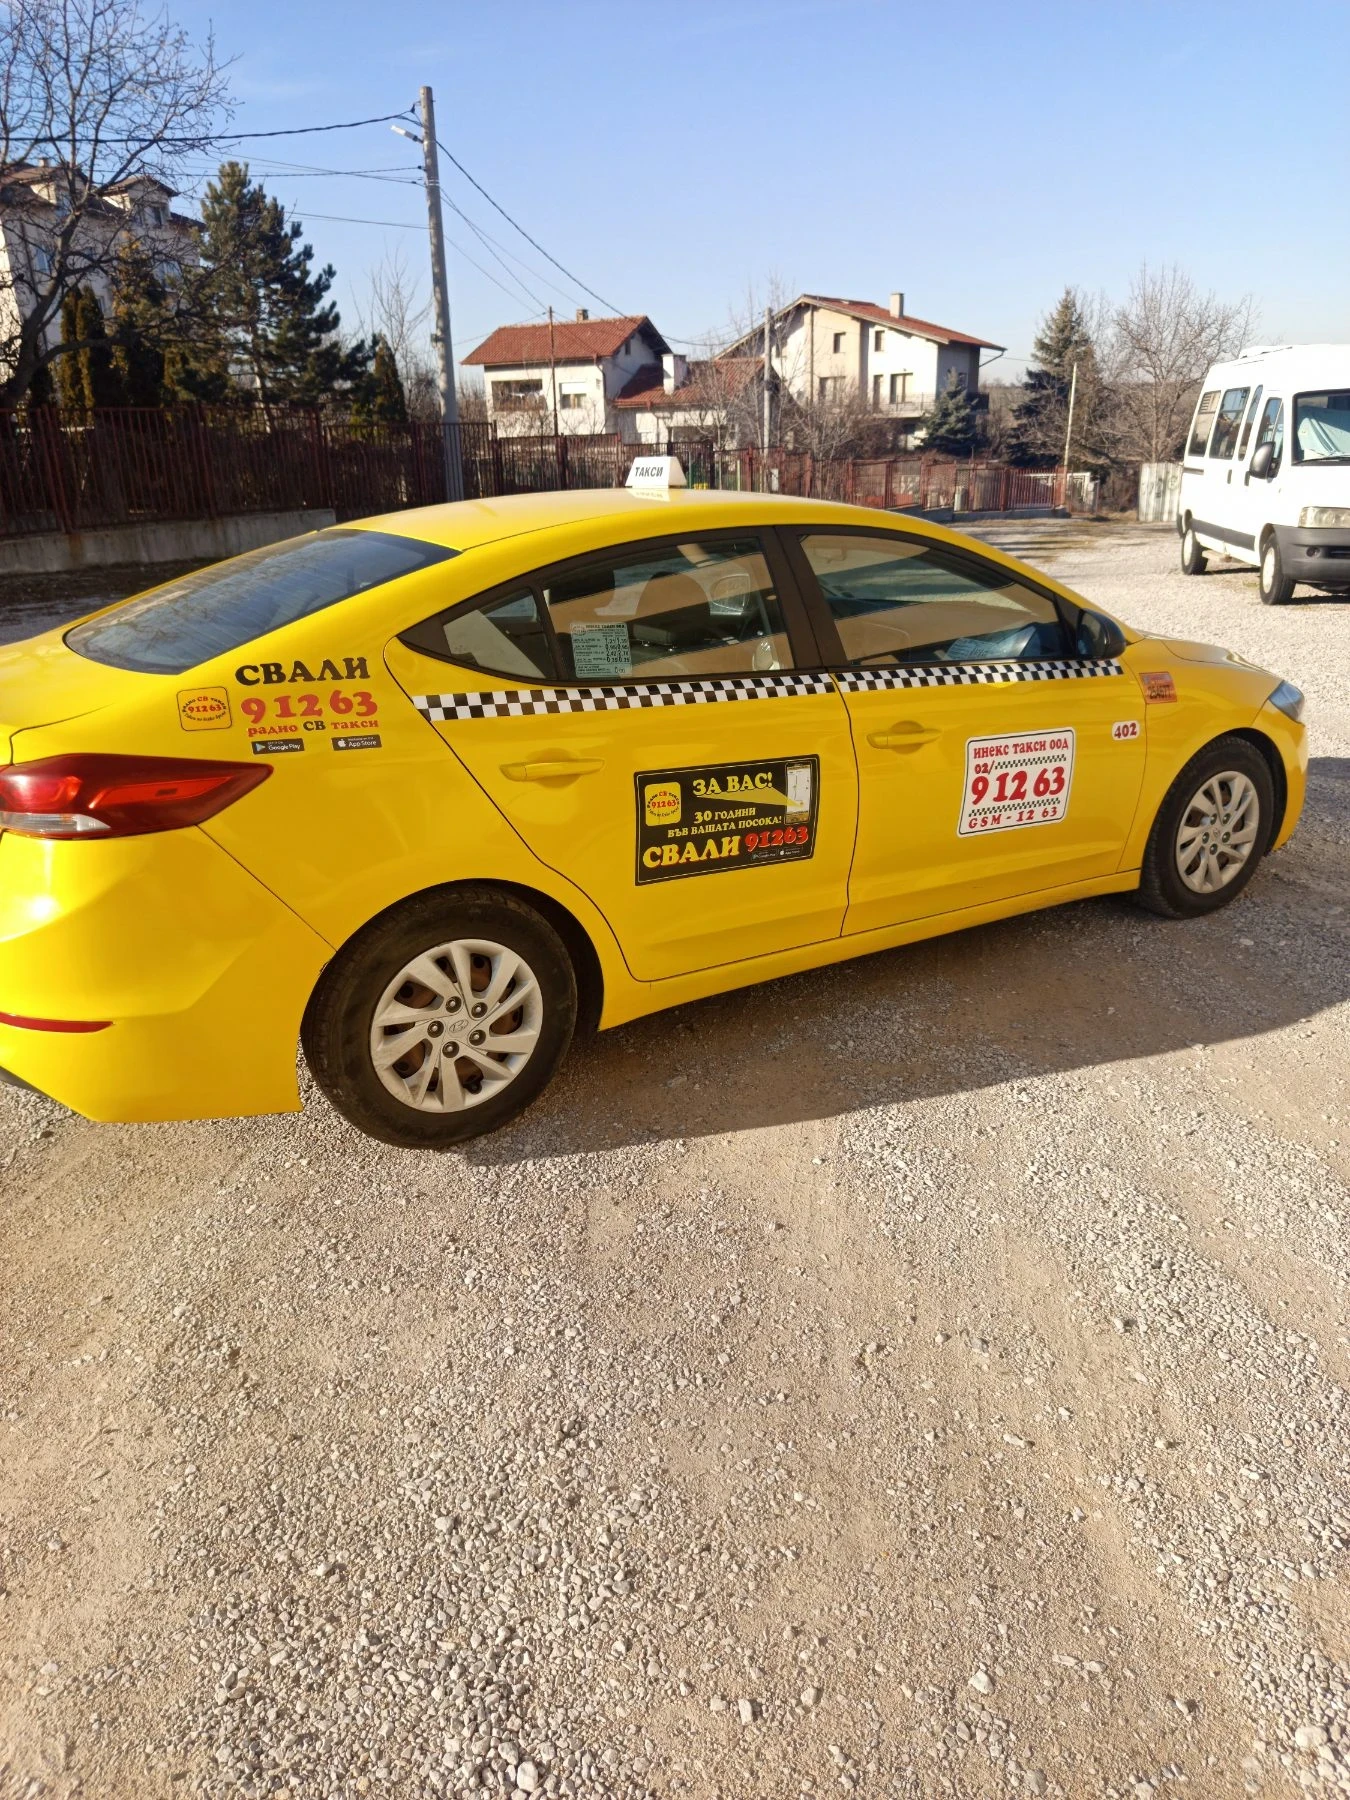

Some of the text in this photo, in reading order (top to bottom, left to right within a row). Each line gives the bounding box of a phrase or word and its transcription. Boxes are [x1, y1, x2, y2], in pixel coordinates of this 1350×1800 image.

[635, 467, 663, 477] ТАКСИ
[235, 657, 370, 686] СВАЛИ
[303, 720, 326, 732] СВ
[331, 720, 379, 730] такси
[1113, 722, 1137, 739] 402
[692, 772, 773, 796] ЗА ВАС!
[693, 810, 712, 824] 30
[714, 807, 757, 820] ГОДИНИ
[667, 815, 782, 838] ВЪВ ВАШАТА ПОСОКА!
[642, 826, 809, 868] СВАЛИ 91263
